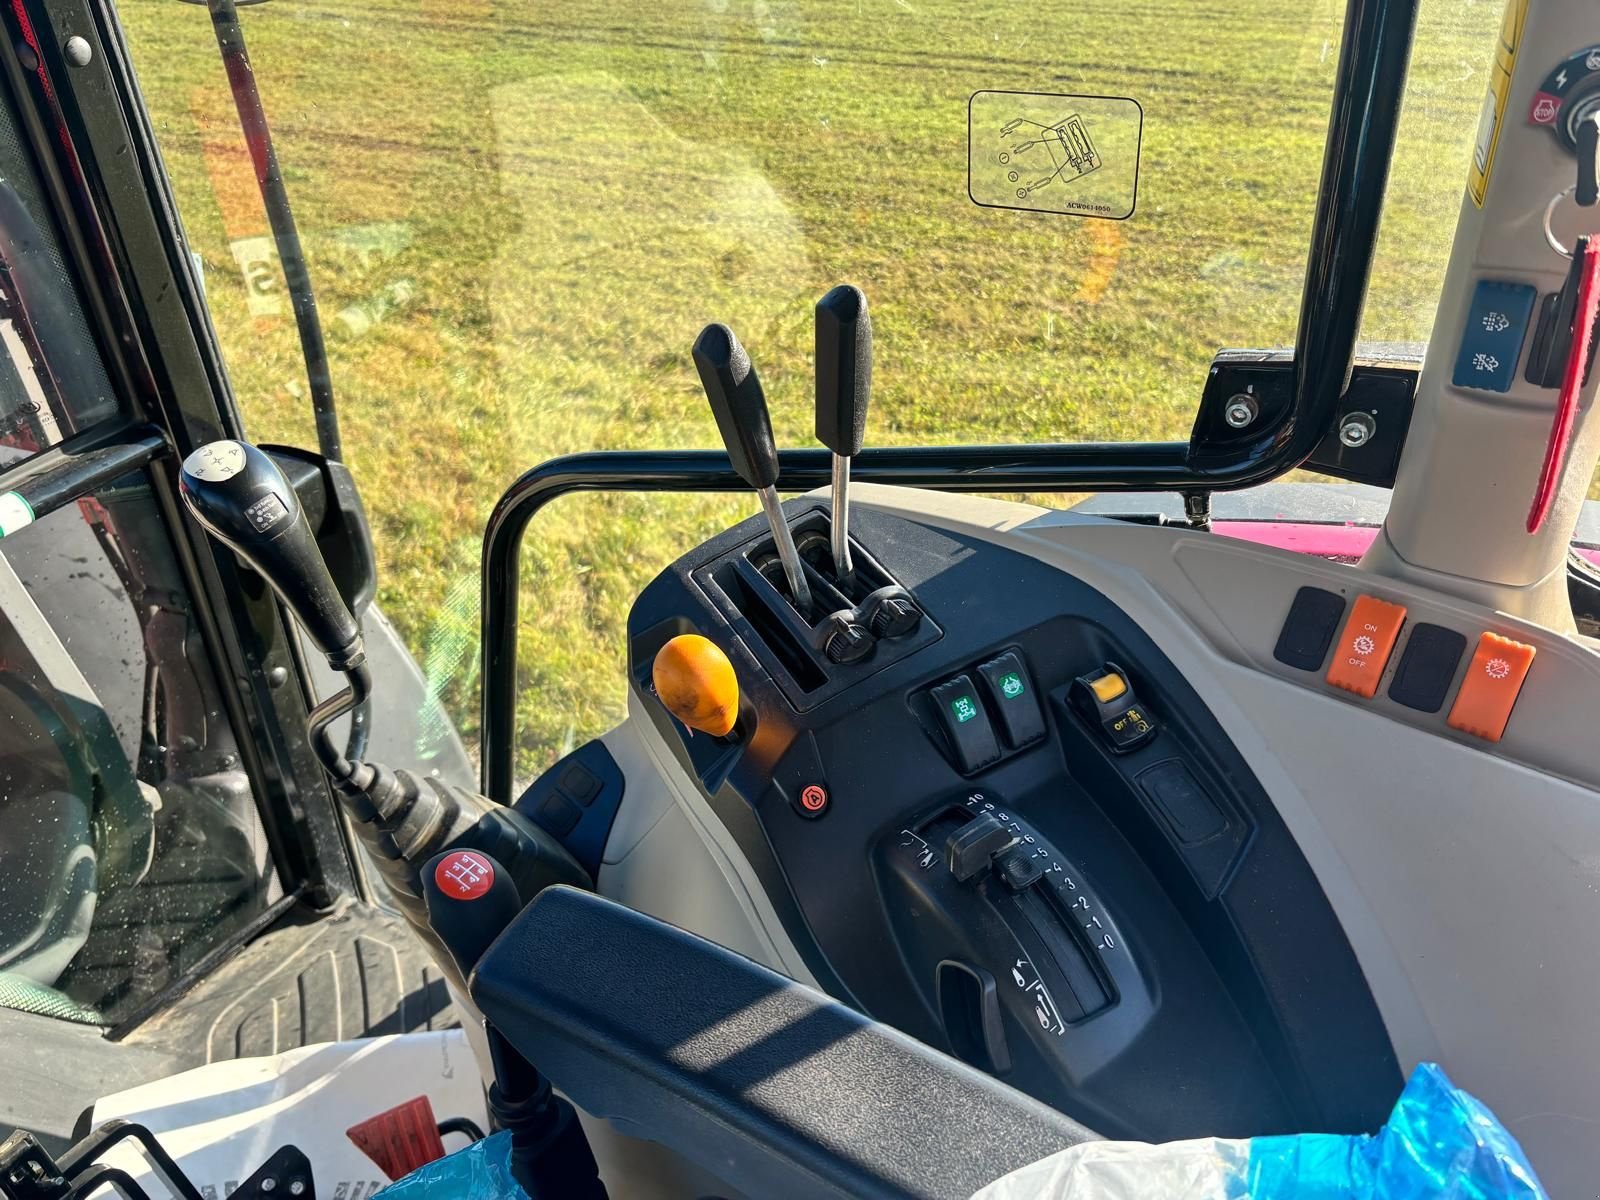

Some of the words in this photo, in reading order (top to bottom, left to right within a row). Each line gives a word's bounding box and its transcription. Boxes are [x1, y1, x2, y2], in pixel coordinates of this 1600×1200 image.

[1364, 623, 1378, 633] ON
[1348, 657, 1366, 668] OFF
[1114, 718, 1128, 731] OFF
[968, 793, 984, 804] 10
[984, 803, 995, 811] 9
[998, 812, 1009, 822] 8
[1010, 822, 1021, 832] 7
[1024, 833, 1035, 844] 6
[1037, 847, 1049, 858] 5
[1053, 862, 1063, 873] 4
[1064, 877, 1076, 890] 3
[1078, 896, 1091, 910] 2
[1092, 915, 1103, 929] 1
[1103, 933, 1115, 949] 0
